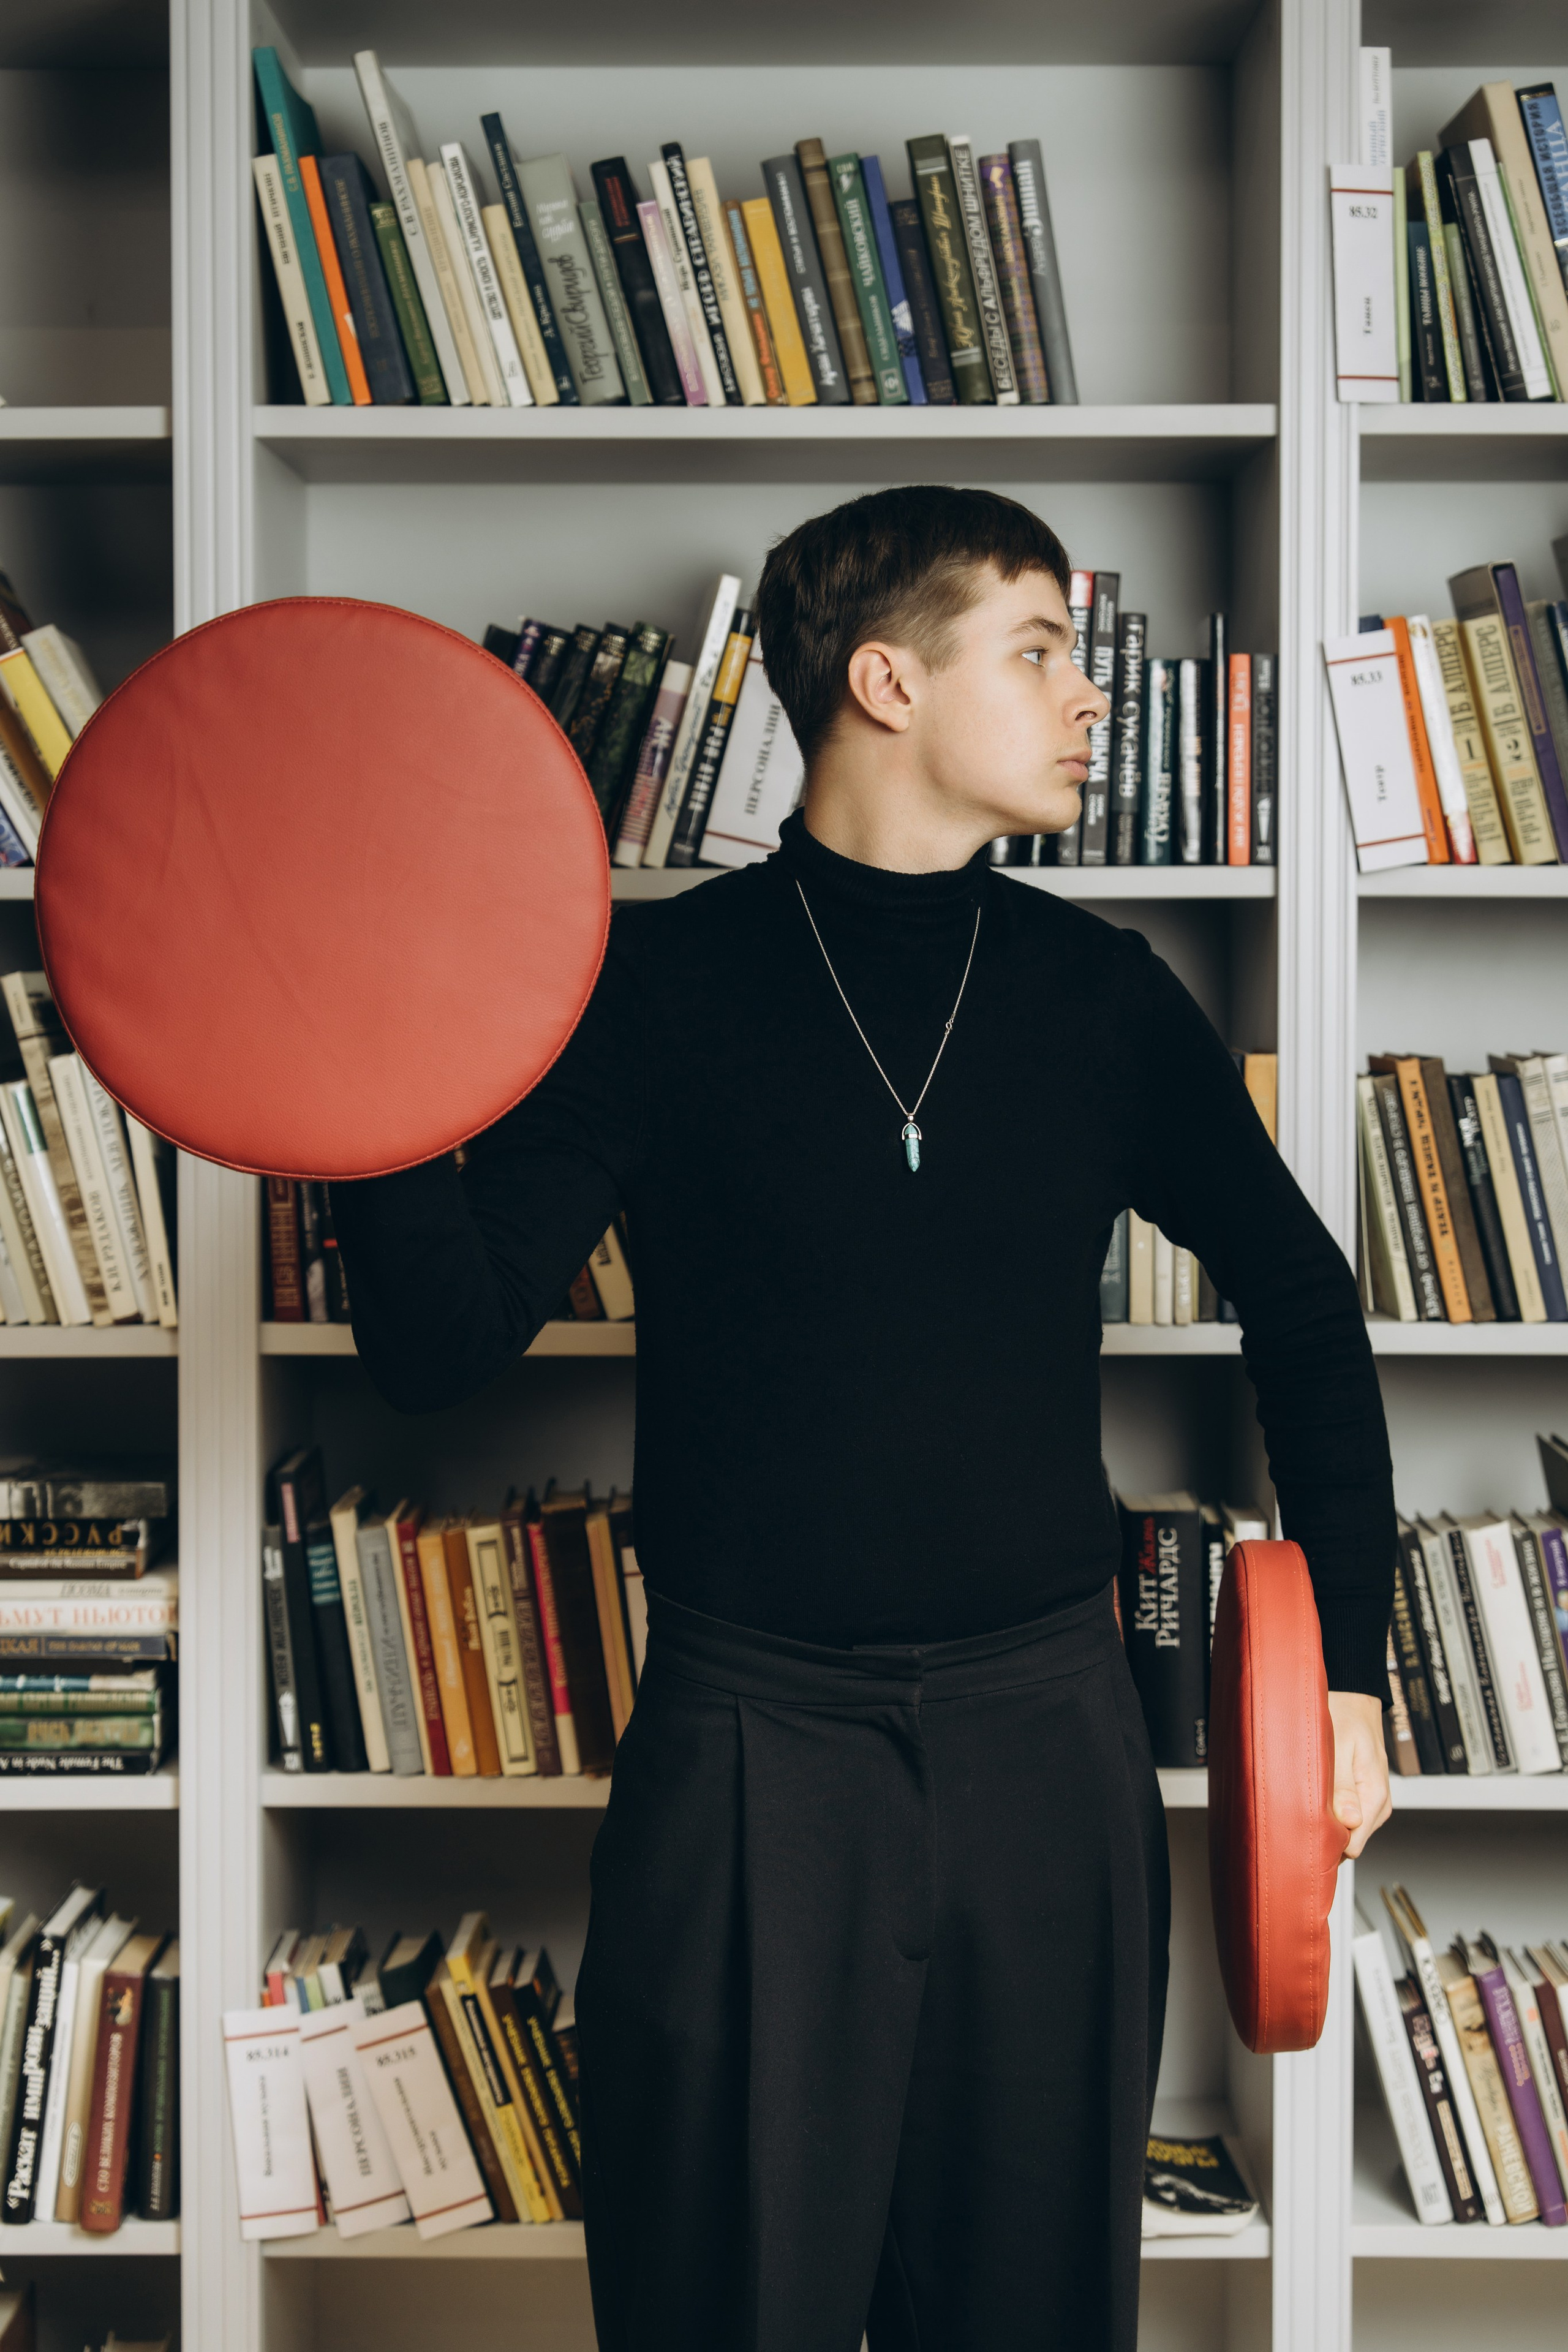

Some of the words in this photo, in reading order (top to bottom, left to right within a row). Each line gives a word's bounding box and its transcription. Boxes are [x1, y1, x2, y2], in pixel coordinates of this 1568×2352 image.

[270, 111, 296, 175] РАХМАНИНОВ
[1526, 100, 1551, 162] ИСТОРИЯ
[262, 172, 281, 218] ПТИЧКИН
[376, 121, 412, 212] РАХМАНИНОВ
[954, 146, 980, 213] ШНИТКЕ
[663, 153, 707, 268] СТРАВИНСКИЙ
[842, 197, 878, 287] ЧАЙКОВСКИЙ
[1349, 205, 1378, 219] 85.32
[273, 222, 291, 265] ЕВГЕНИЙ
[475, 255, 492, 285] ЮНОСТЬ
[967, 214, 1000, 311] АЛЬФРЕДОМ
[546, 250, 598, 328] Свиридов
[695, 268, 721, 325] ИГОРЬ
[984, 310, 1000, 325] С
[988, 324, 1014, 390] БЕСЕДЫ
[1091, 646, 1115, 687] ПУТЬ
[1118, 622, 1144, 695] гарик
[1350, 670, 1384, 687] 85.33
[1433, 624, 1467, 696] АЛПЕРС
[1474, 624, 1510, 696] АЛПЕРС
[743, 703, 781, 816] ПЕРСОНАЛИИ
[1114, 699, 1144, 798] сукачёв
[1505, 737, 1523, 762] 2
[102, 1756, 123, 1770] The
